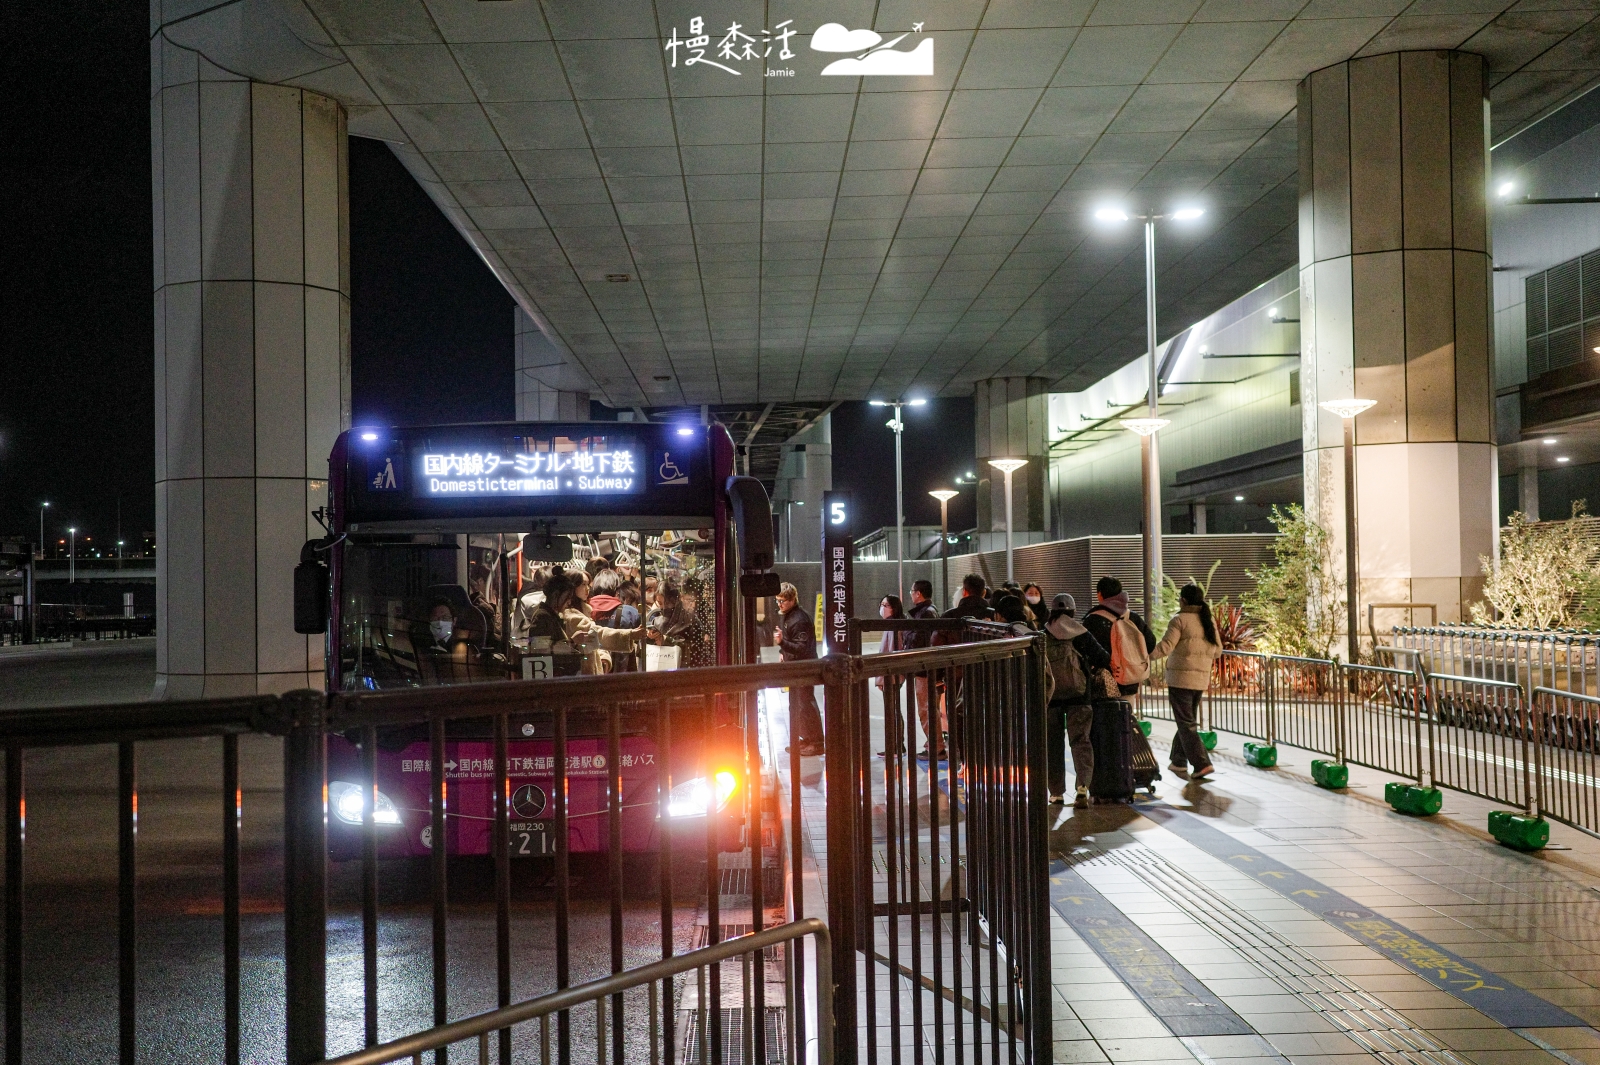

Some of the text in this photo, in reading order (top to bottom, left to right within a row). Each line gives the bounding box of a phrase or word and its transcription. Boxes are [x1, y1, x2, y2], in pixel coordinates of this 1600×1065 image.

[424, 452, 634, 476] 国内線ターミナル・地下鉄
[578, 475, 632, 490] Subway
[831, 502, 846, 525] 5
[833, 547, 847, 642] 国内線(地下鉄)行
[618, 754, 655, 768] 絡バス
[445, 771, 469, 779] Shuttle
